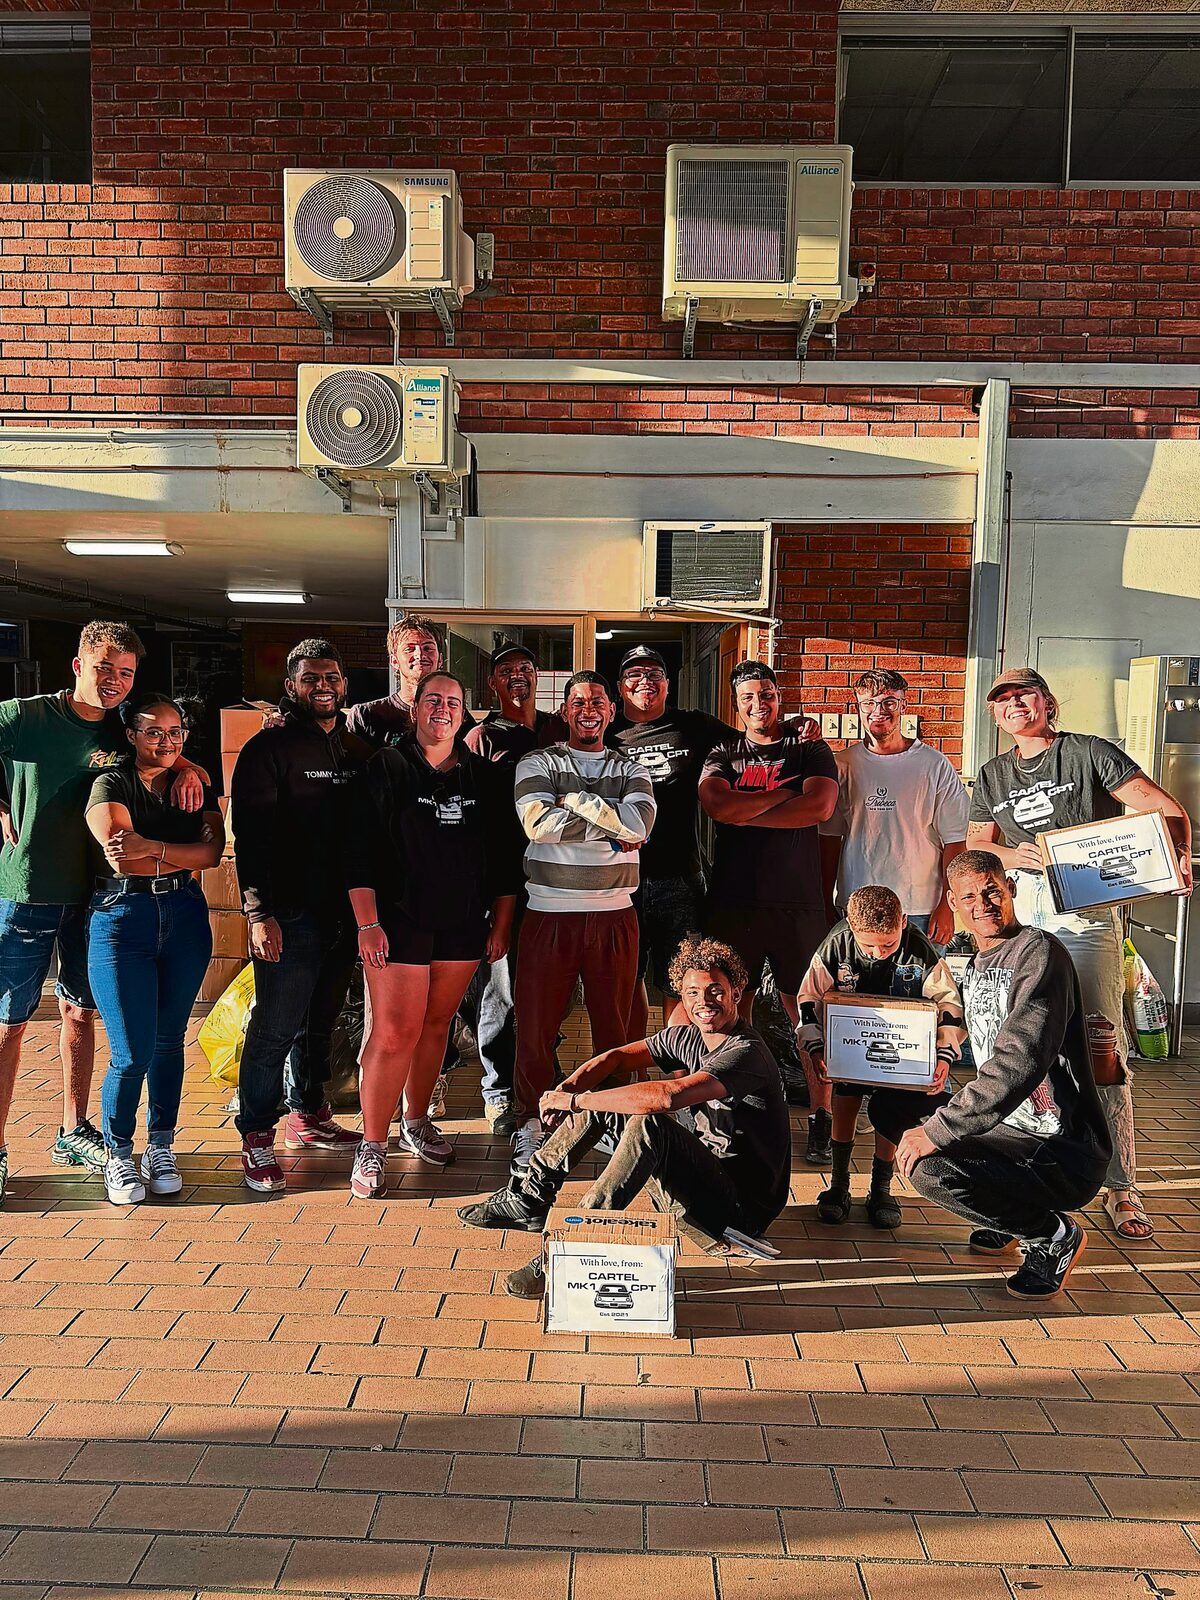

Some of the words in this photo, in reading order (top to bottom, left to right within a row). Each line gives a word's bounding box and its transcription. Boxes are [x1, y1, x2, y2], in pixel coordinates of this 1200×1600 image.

[801, 165, 839, 175] Alliance
[404, 177, 449, 186] SAMSUNG
[628, 743, 674, 755] CARTEL
[666, 749, 689, 759] CPT
[304, 770, 332, 778] TOMMY
[1009, 780, 1055, 798] CARTEL
[993, 798, 1016, 814] MK1
[1048, 782, 1075, 797] CPT
[1077, 839, 1096, 850] With
[1096, 836, 1115, 845] love,
[1115, 832, 1136, 842] from:
[1088, 844, 1136, 858] CARTEL
[1071, 860, 1098, 872] MK1
[1129, 849, 1153, 859] CPT
[853, 1019, 871, 1027] With
[871, 1020, 888, 1029] love,
[889, 1022, 908, 1030] from:
[860, 1031, 905, 1040] CARTEL
[842, 1038, 867, 1046] MK1
[897, 1042, 920, 1050] CPT
[585, 1217, 658, 1228] takealot
[580, 1258, 600, 1267] With
[601, 1259, 620, 1268] love,
[621, 1259, 643, 1268] from:
[588, 1272, 640, 1282] CARTEL
[567, 1282, 596, 1291] MK1
[631, 1284, 657, 1292] CPT
